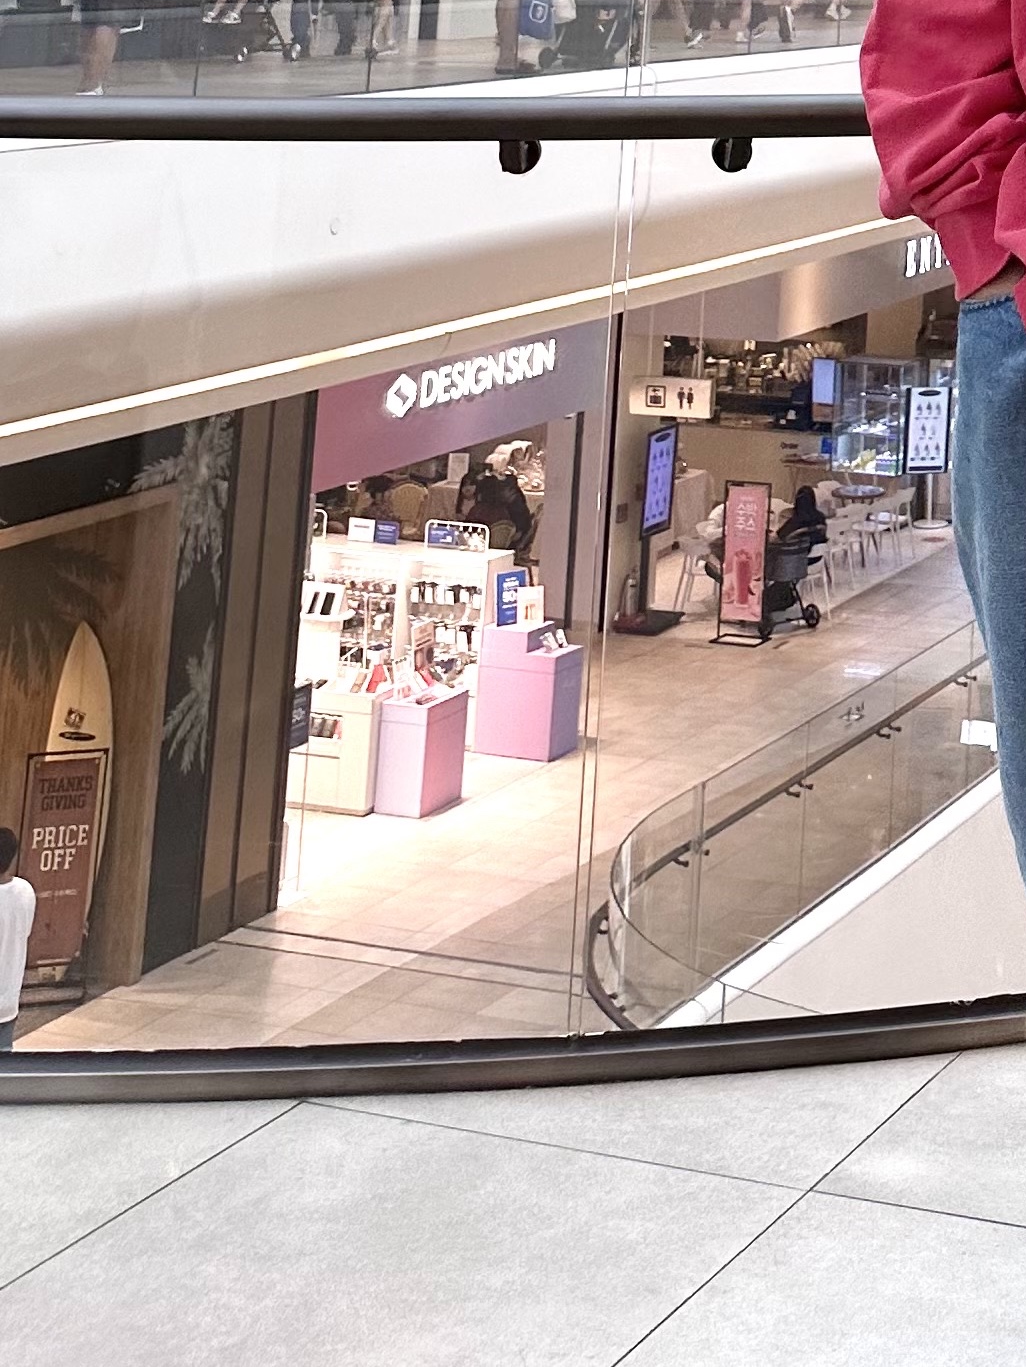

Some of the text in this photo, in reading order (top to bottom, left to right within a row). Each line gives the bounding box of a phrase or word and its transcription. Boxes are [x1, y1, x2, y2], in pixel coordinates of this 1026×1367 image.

[419, 338, 557, 409] DESIGNSKIN
[39, 775, 93, 794] THANKS
[41, 793, 87, 811] GIVING
[31, 824, 89, 850] PRICE
[40, 848, 76, 872] OFF
